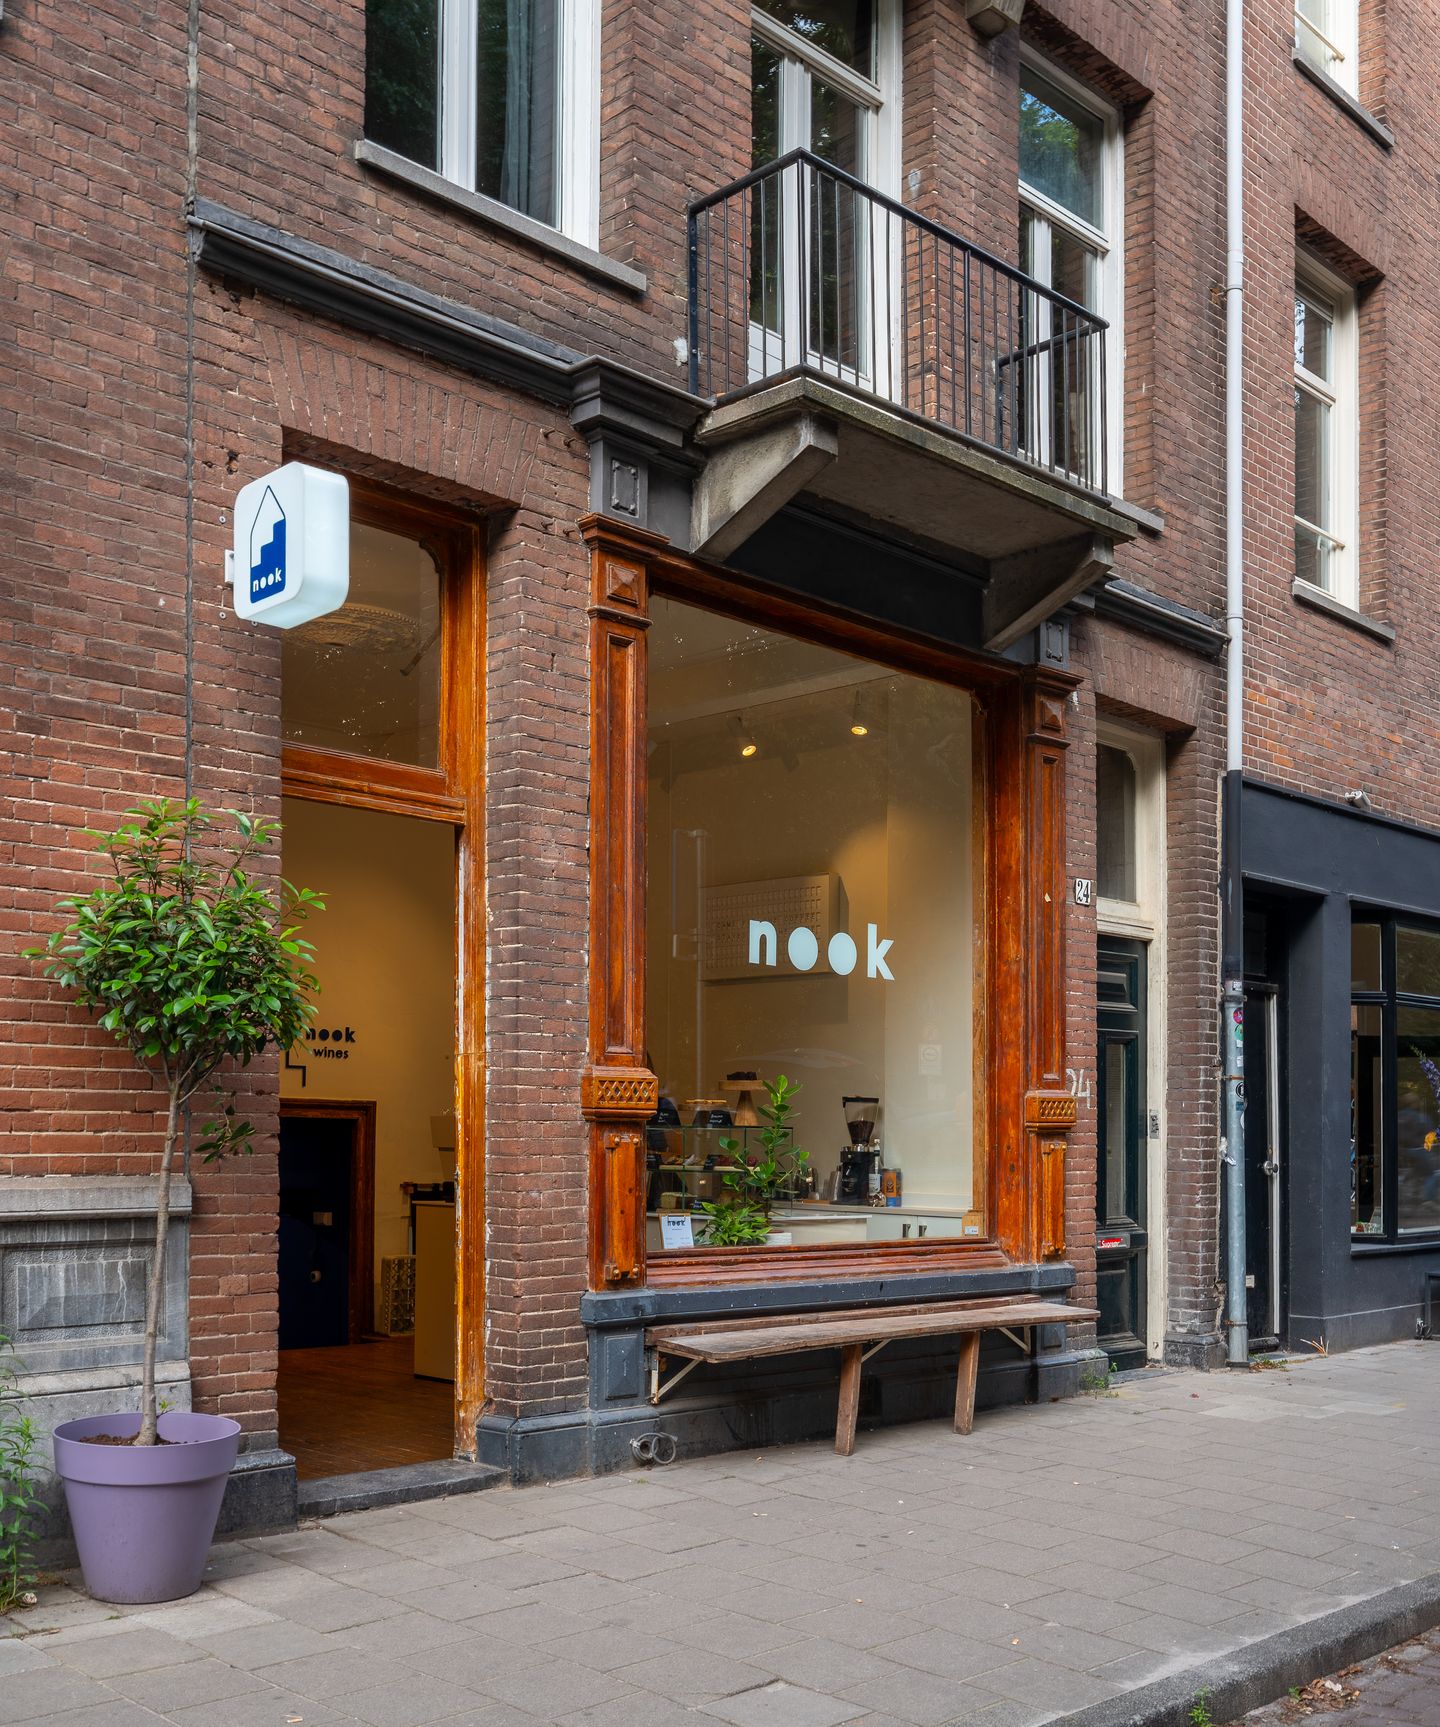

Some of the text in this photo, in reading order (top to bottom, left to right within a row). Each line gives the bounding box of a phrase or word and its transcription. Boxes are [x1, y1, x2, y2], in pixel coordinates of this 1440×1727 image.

[252, 567, 282, 592] nook
[1077, 880, 1090, 903] 24
[748, 919, 895, 981] nook
[306, 1026, 356, 1043] nook
[313, 1046, 349, 1059] wines
